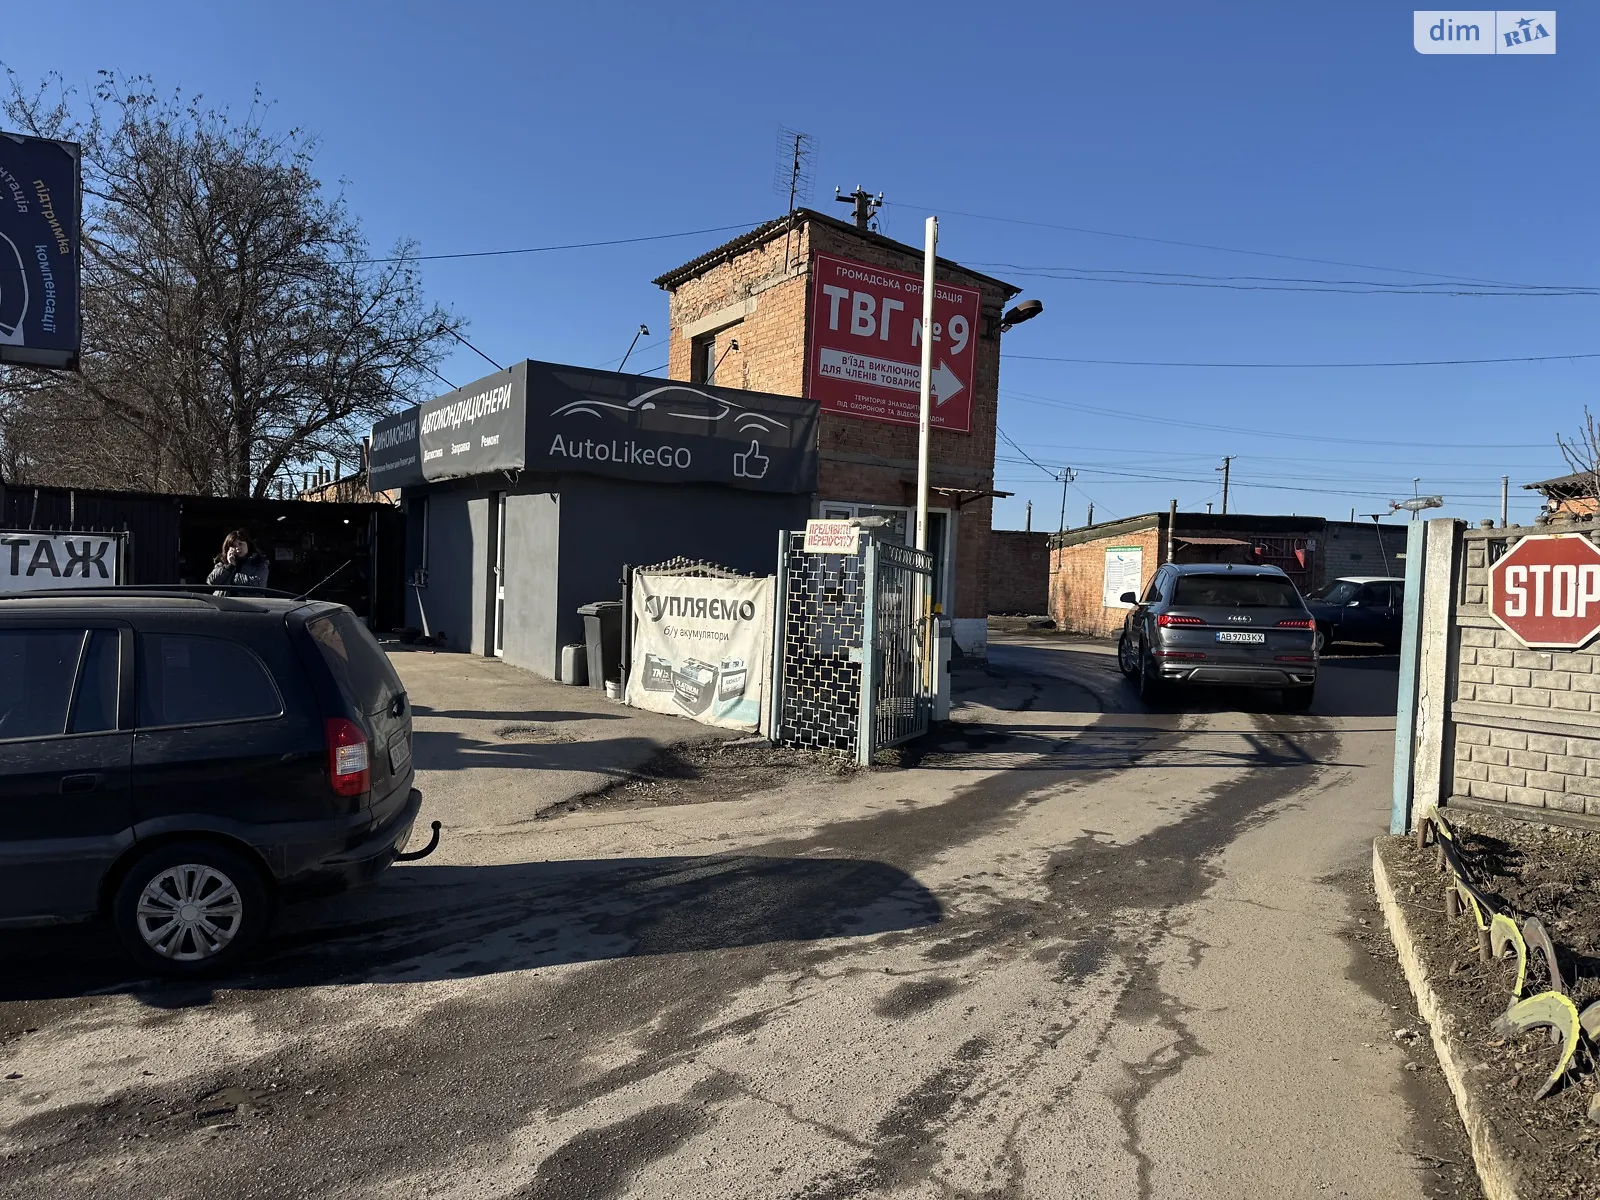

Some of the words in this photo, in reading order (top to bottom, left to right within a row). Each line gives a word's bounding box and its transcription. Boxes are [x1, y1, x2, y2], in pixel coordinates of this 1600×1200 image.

[33, 180, 70, 255] підтримка
[35, 244, 56, 333] компенсації
[836, 267, 900, 290] ГРОМАДСЬКА
[905, 283, 963, 304] ОРГІЗАЦІЯ
[823, 284, 904, 341] ТВГ
[822, 363, 841, 375] ДЛЯ
[845, 368, 877, 381] ЧЛЕНІВ
[881, 375, 936, 391] ТОВАРИСА
[869, 361, 919, 378] ВИКЛЮЧНО
[421, 383, 512, 435] АВТОКОНДИЦІОНЕРИ
[836, 400, 848, 408] ПІД
[850, 402, 885, 414] ОХОРОНОЮ
[855, 394, 886, 405] ТЕРИТОРІЯ
[549, 434, 692, 468] AutoLikeGO
[0, 539, 110, 578] ТАЖ
[1505, 564, 1600, 617] STOP
[663, 625, 678, 639] б/у
[680, 629, 729, 642] акумулятори
